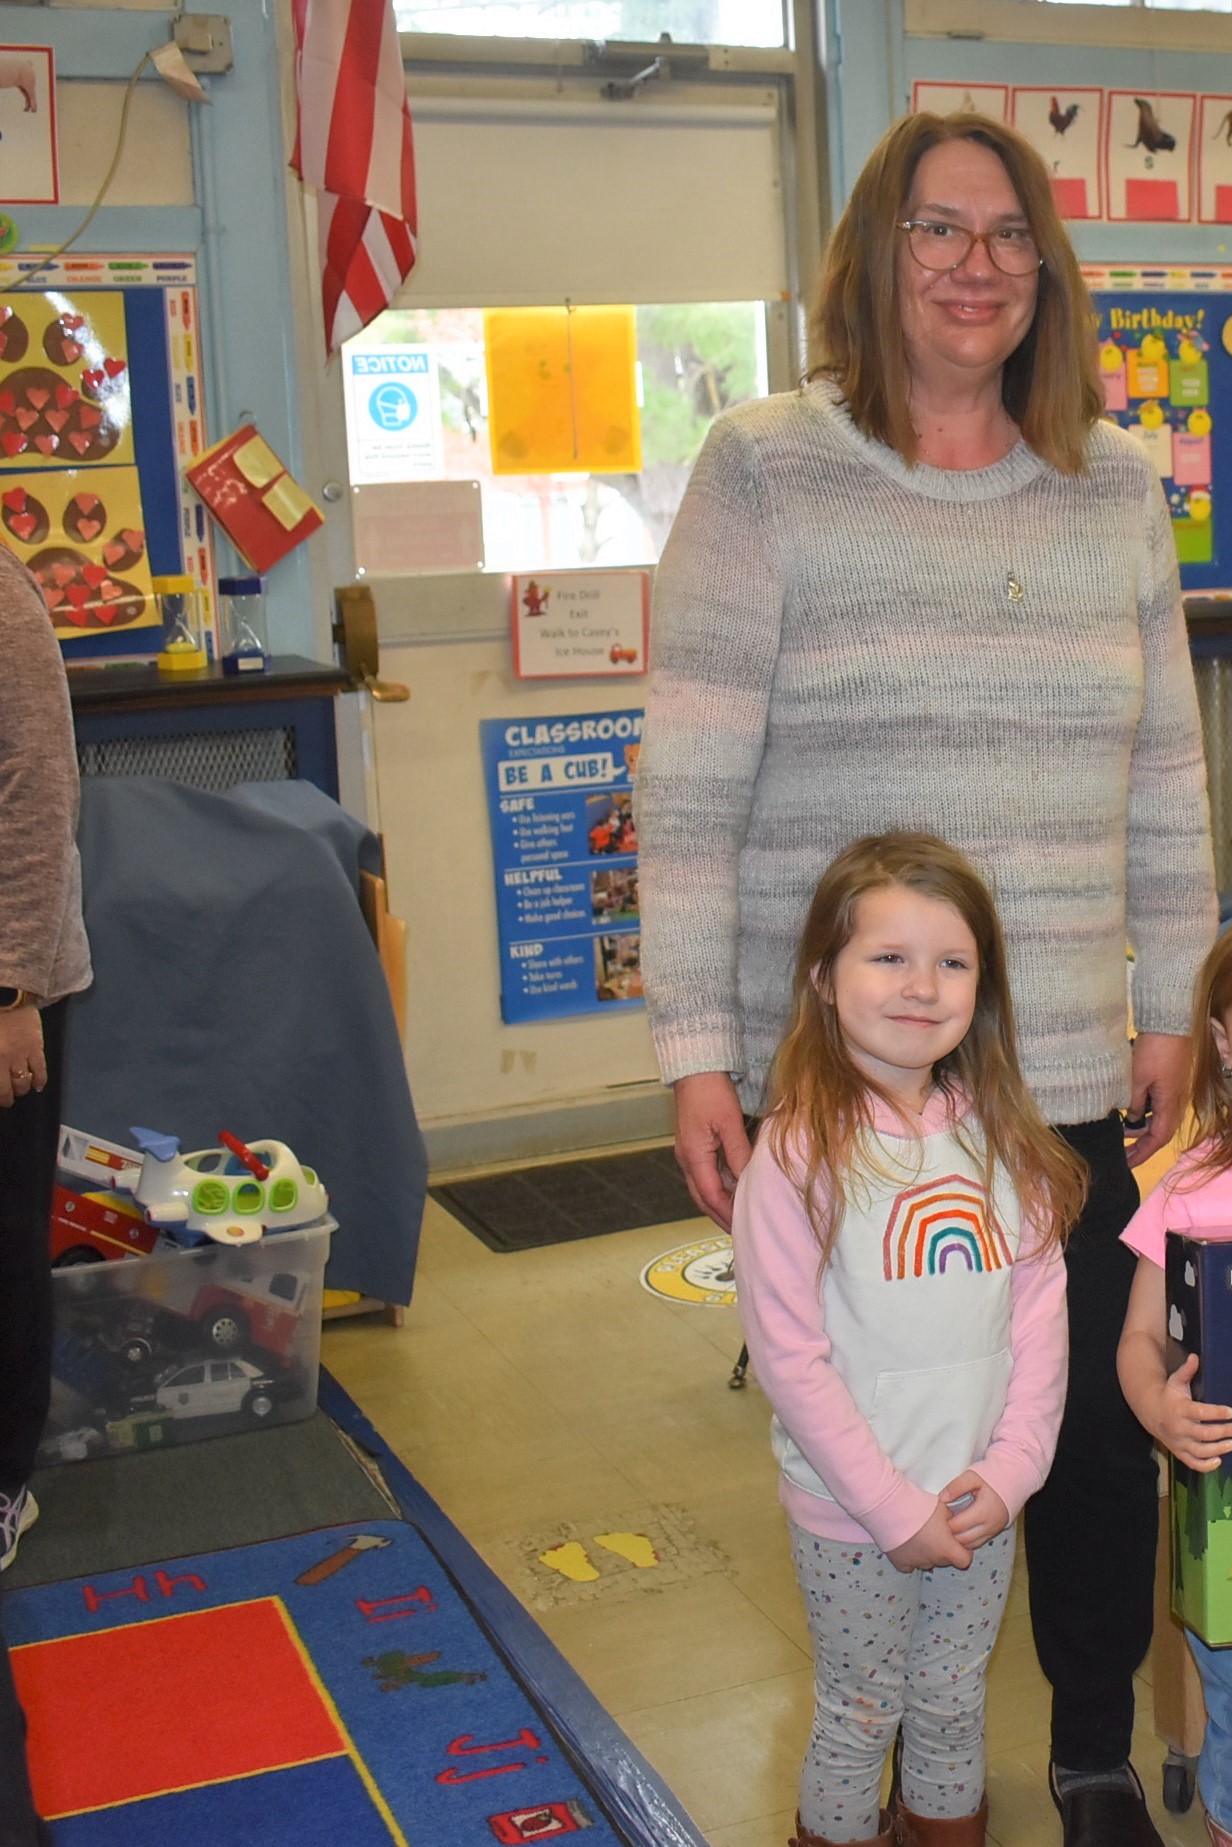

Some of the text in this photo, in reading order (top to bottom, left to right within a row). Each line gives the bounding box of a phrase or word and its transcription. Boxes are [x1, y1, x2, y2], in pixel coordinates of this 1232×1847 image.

[1109, 307, 1205, 333] Birthday!
[557, 590, 600, 600] Fire Drill
[569, 610, 589, 619] Exit
[540, 628, 564, 639] Walk
[568, 628, 579, 638] to
[555, 646, 605, 657] Ice House
[505, 758, 608, 785] BE A CUB!
[500, 797, 535, 813] SAFE
[504, 869, 562, 886] HELPFUL
[509, 944, 544, 959] KIND
[82, 1569, 208, 1613] Hh
